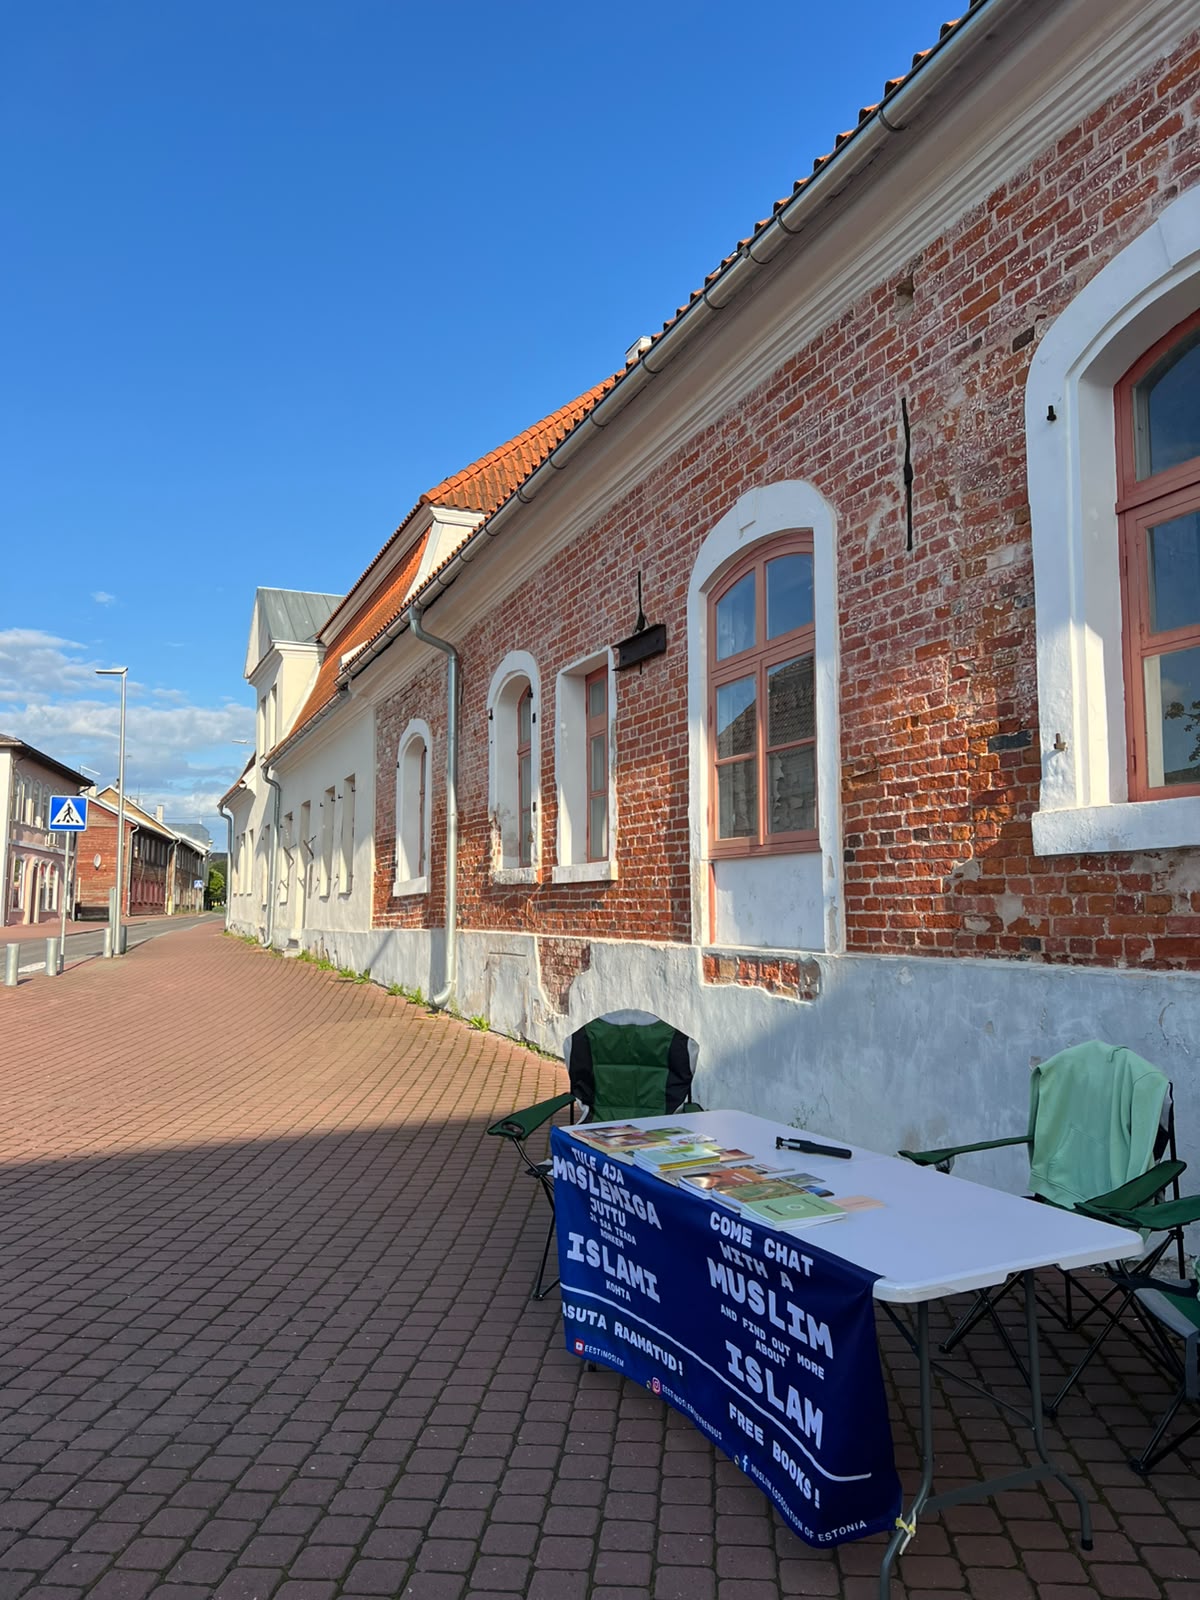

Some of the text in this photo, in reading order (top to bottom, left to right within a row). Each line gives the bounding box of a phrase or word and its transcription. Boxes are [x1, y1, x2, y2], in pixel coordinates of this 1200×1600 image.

[571, 1147, 625, 1185] TULE AJA
[553, 1155, 662, 1230] MOSLEMIGA
[589, 1197, 626, 1227] JUTTU
[589, 1212, 637, 1246] JA SAA TEADA
[710, 1211, 814, 1277] COME CHAT
[567, 1232, 661, 1304] ISLAMI
[605, 1279, 632, 1302] KOHTA
[719, 1240, 794, 1293] WITH A
[707, 1256, 834, 1360] MUSLIM
[720, 1303, 825, 1380] AND FIND OUT MORE
[755, 1340, 786, 1368] ABOUT
[725, 1339, 823, 1450] ISLAM
[729, 1402, 764, 1446] FREE
[804, 1526, 815, 1539] OF
[817, 1519, 867, 1542] ESTONIA
